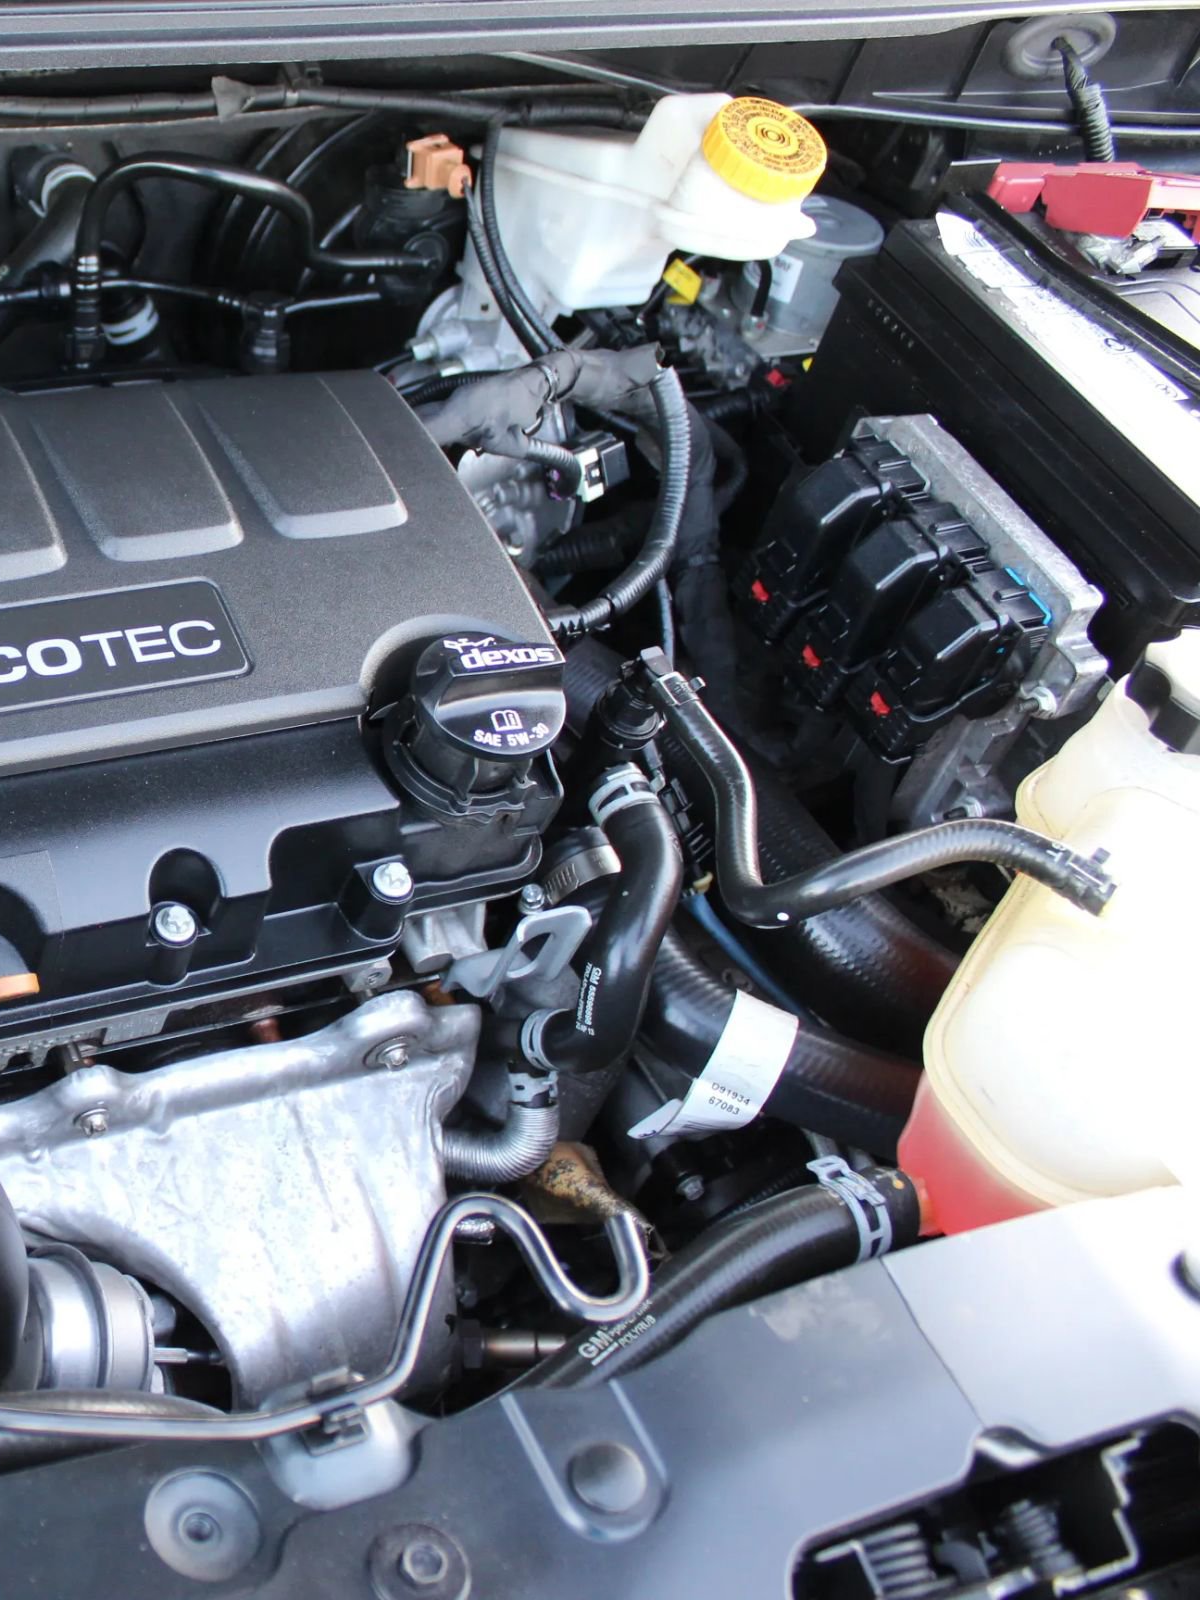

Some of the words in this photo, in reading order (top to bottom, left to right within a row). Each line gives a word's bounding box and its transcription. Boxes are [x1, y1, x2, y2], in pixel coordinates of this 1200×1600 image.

[460, 648, 556, 669] dexos
[473, 729, 502, 746] SAE
[506, 722, 550, 746] 5W-30
[590, 967, 602, 985] GM
[708, 1096, 741, 1115] 67083
[578, 1330, 613, 1359] GM
